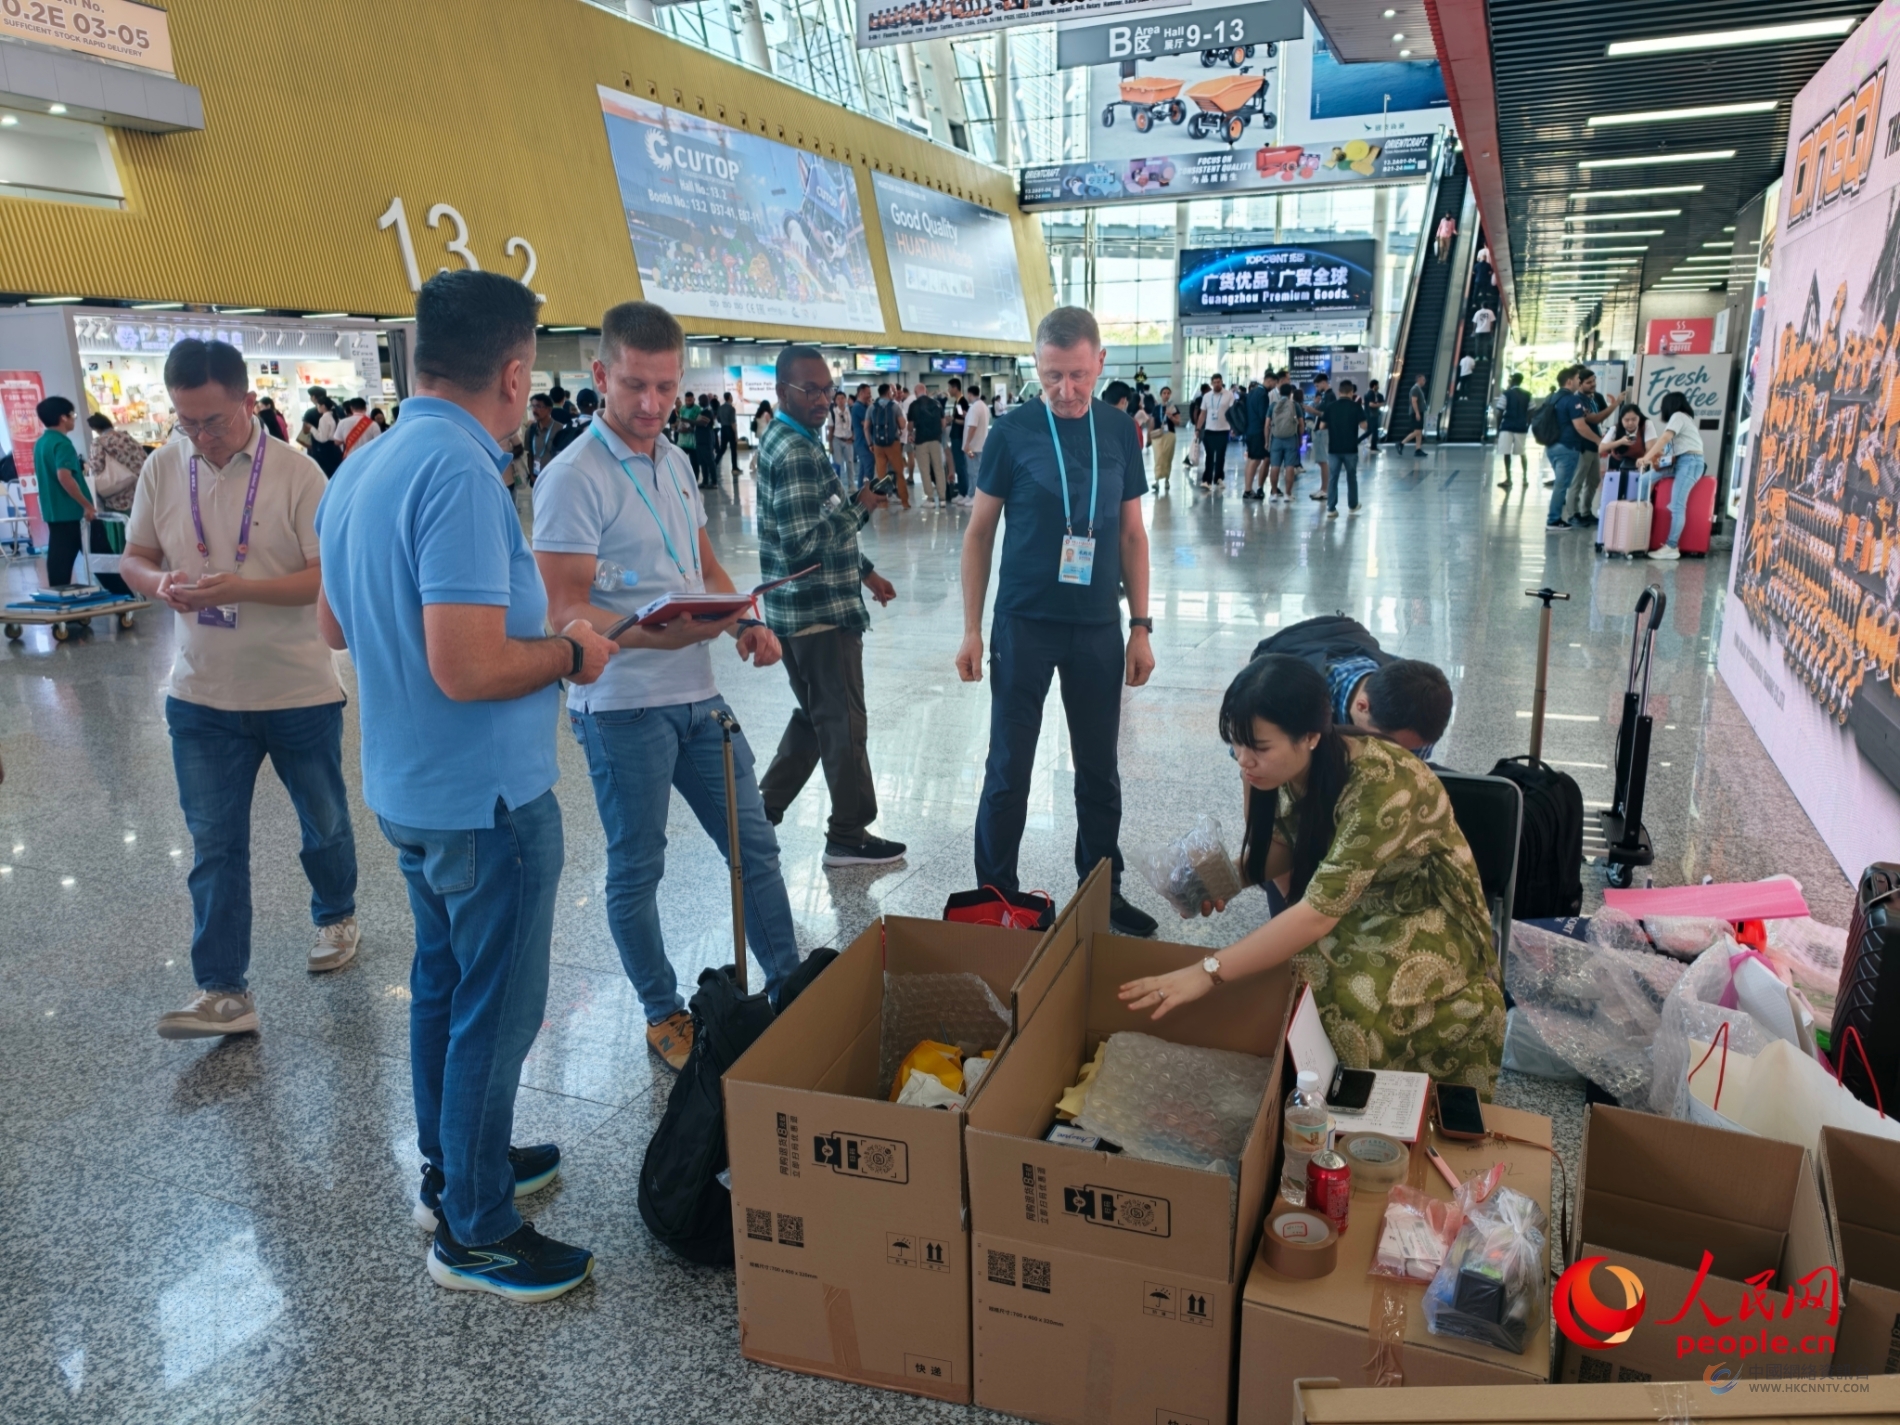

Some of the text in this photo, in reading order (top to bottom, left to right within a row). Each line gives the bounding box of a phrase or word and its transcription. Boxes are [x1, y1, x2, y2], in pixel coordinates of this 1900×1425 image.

[0, 0, 150, 49] 0.2E 03-05
[3, 18, 142, 57] SUFFICIENT STOCK RAPID DELIVERY
[1164, 18, 1244, 47] Hall 9-13
[1109, 26, 1160, 58] B Area
[1134, 35, 1152, 55] 区
[1164, 38, 1184, 50] 展厅
[674, 145, 740, 181] CUTOP
[1197, 154, 1233, 166] FOCUS ON
[1221, 161, 1252, 173] QUALITY
[647, 188, 672, 206] Booth
[679, 178, 694, 193] Hall
[890, 202, 957, 246] Good Quality
[895, 231, 947, 263] HUATIAN
[1202, 266, 1348, 292] 广货优品 广贸全球
[1202, 288, 1349, 306] Guangzhou Premium Goods.
[1647, 365, 1711, 397] Fresh
[1648, 386, 1719, 416] Cffee
[915, 1362, 942, 1377] 快递
